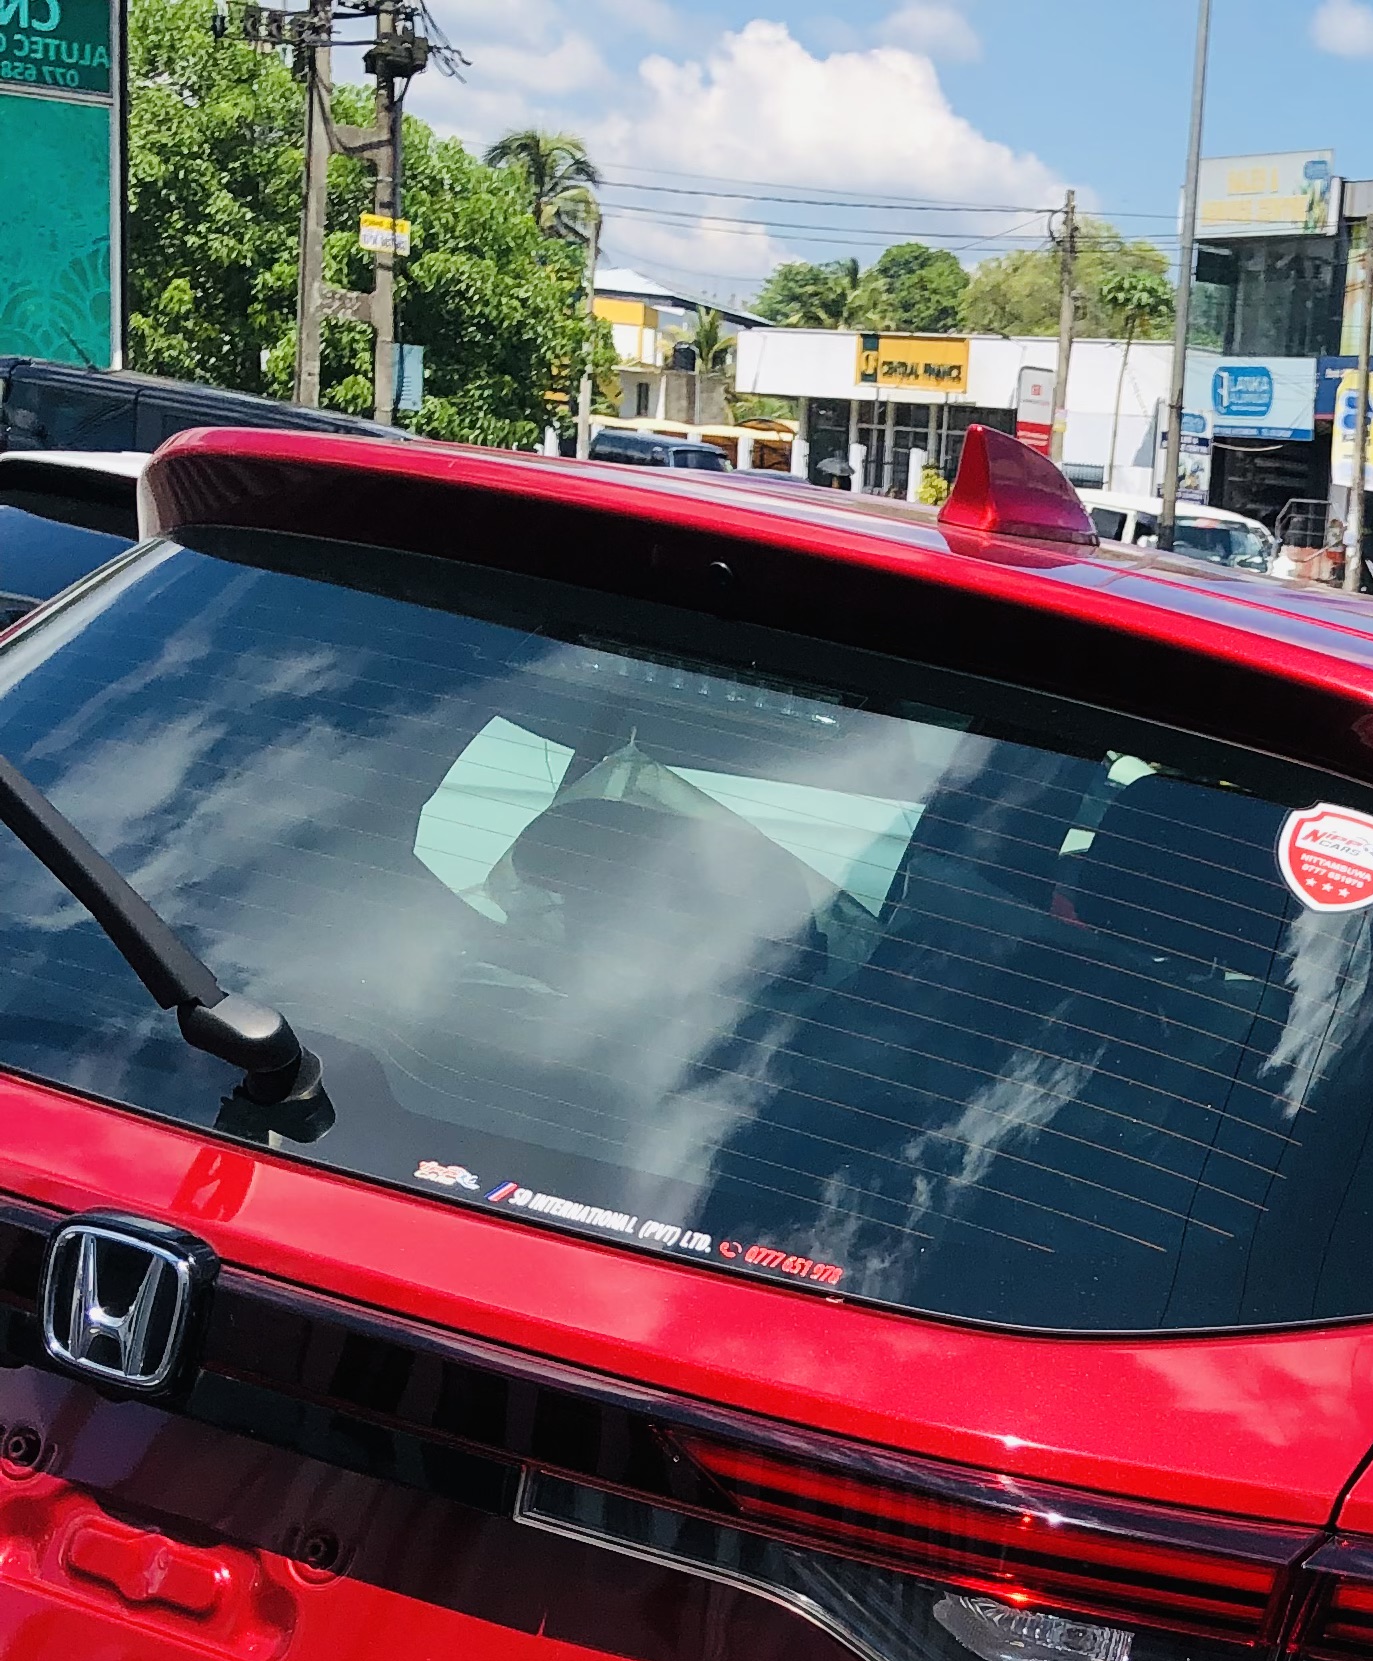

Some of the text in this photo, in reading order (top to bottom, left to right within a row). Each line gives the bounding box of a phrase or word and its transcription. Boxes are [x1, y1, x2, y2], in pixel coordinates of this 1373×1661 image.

[1318, 840, 1361, 856] CARS
[1300, 853, 1372, 882] NITTAMBUWA
[1301, 863, 1327, 876] 0777
[508, 1187, 712, 1254] SD INTERNATIONAL (PVT) LTD.
[744, 1244, 844, 1286] 0777 651 978
